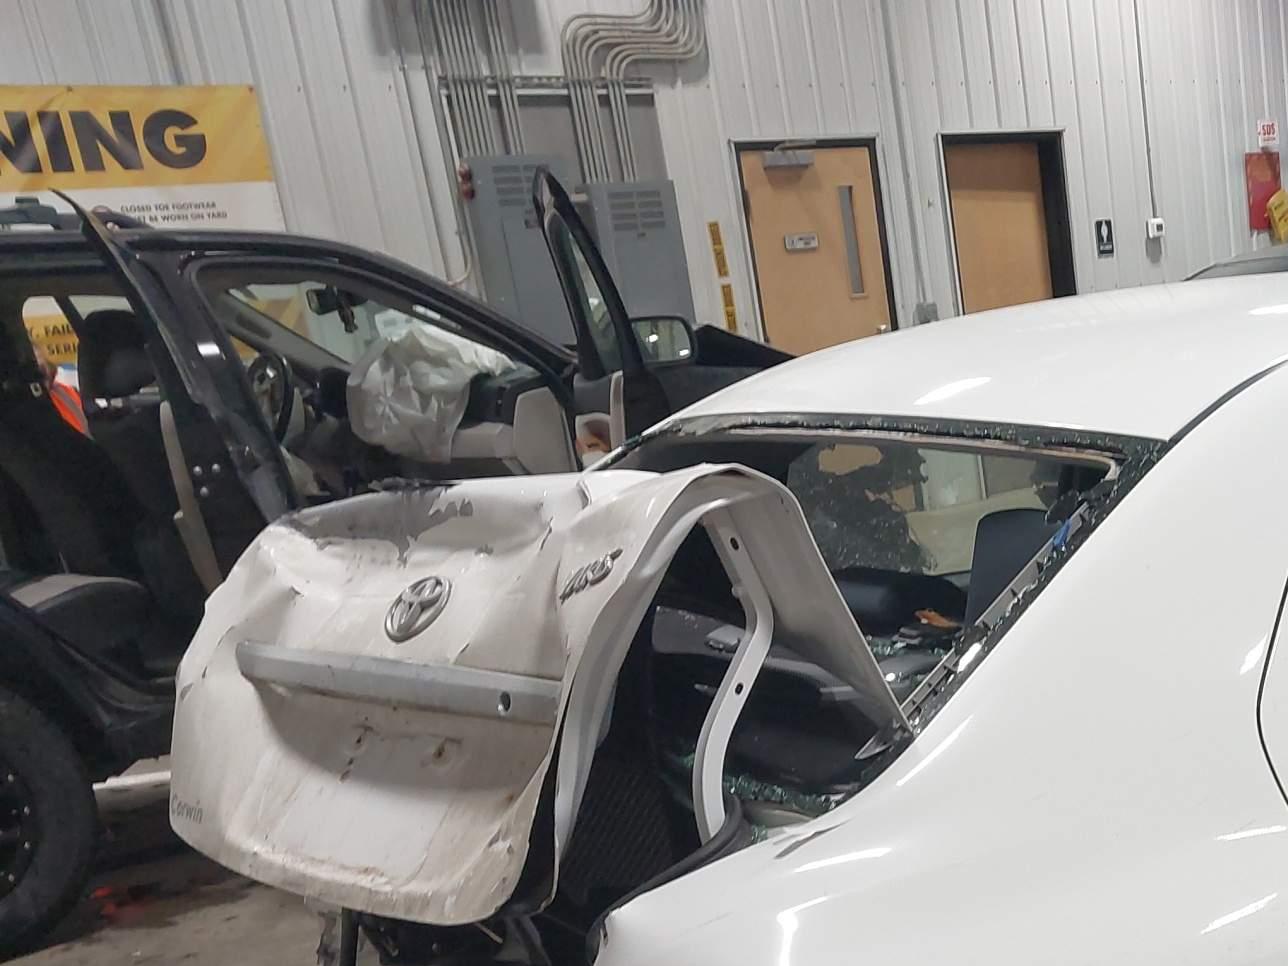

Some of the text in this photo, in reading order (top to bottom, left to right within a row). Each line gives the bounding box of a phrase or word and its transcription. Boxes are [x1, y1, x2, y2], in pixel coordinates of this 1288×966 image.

[120, 201, 216, 213] CLOSED TOE FOOTWEAR
[161, 213, 188, 221] WORN
[207, 211, 228, 219] YARD
